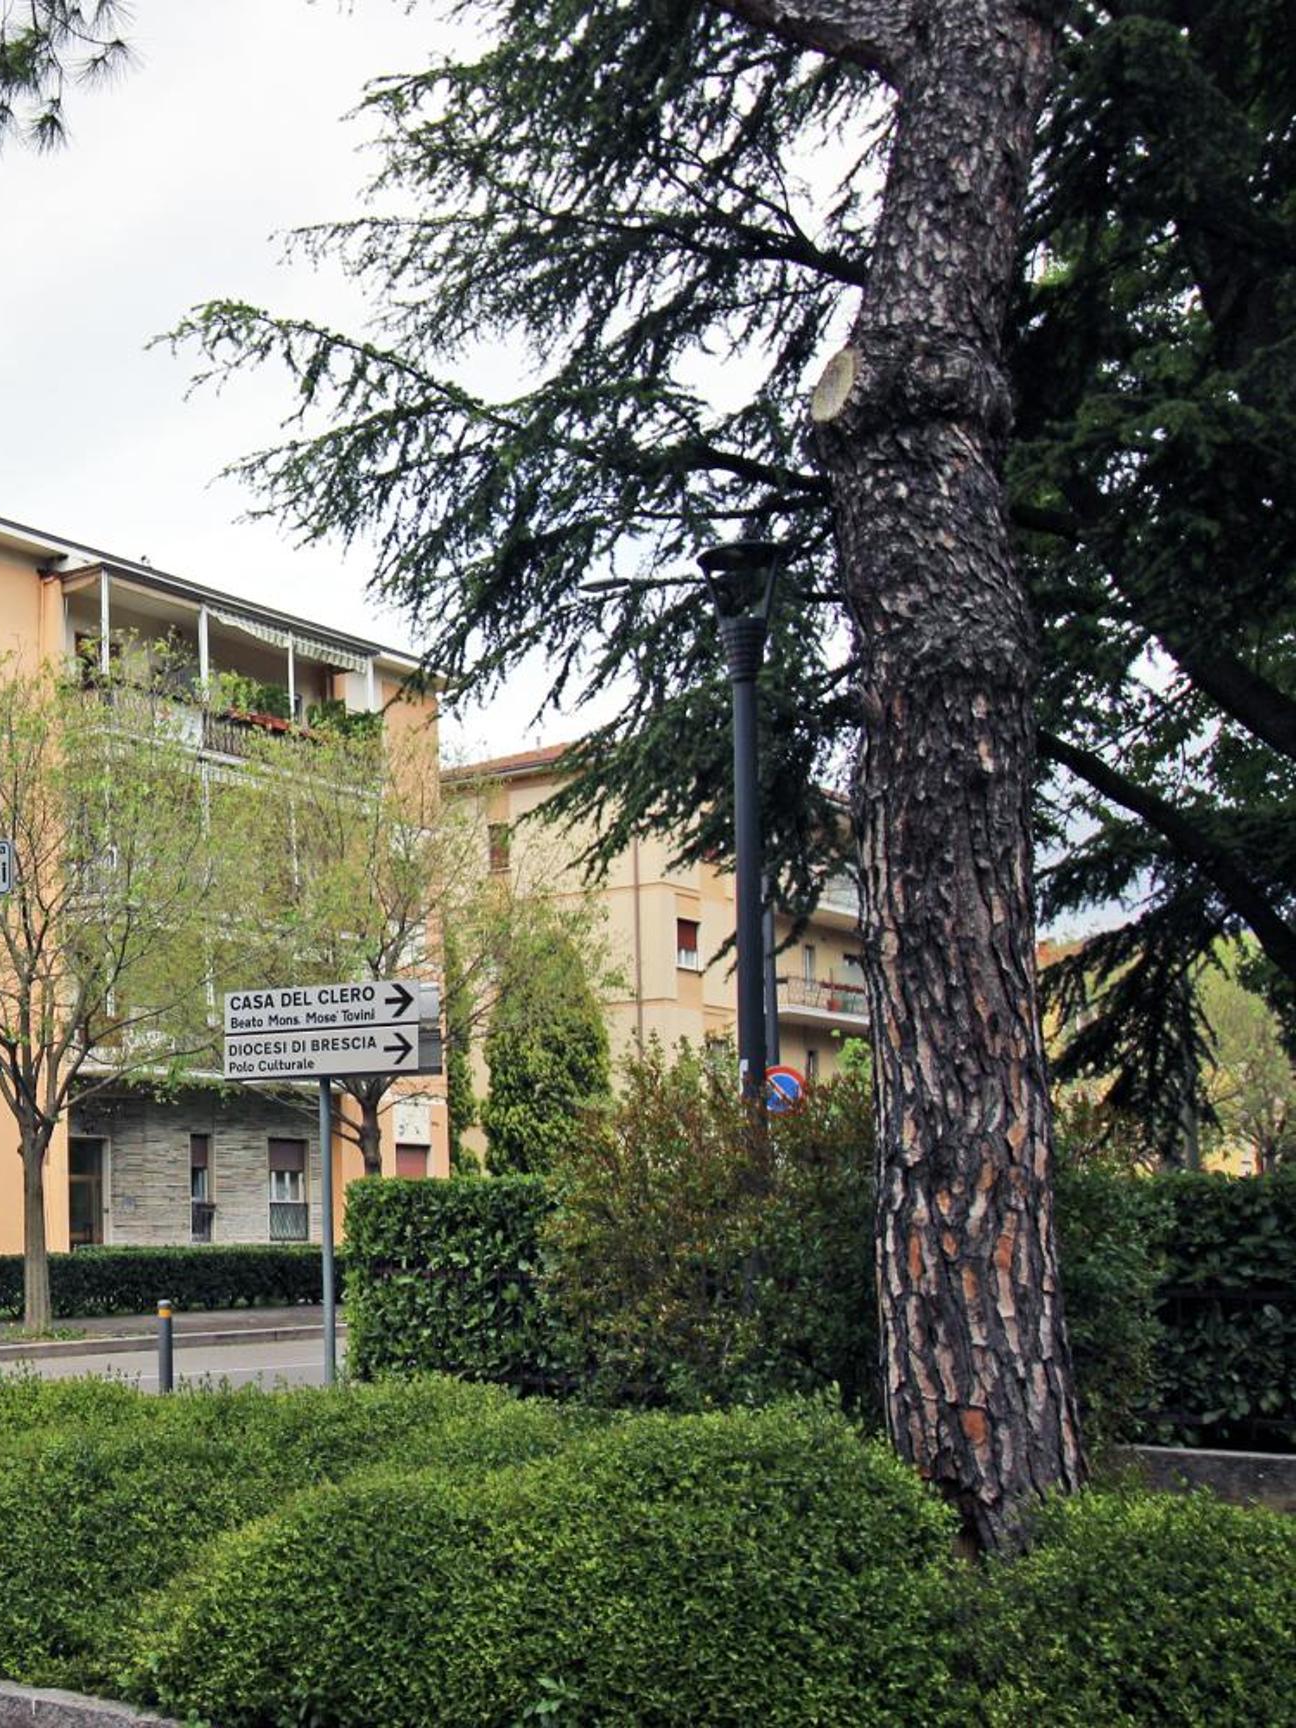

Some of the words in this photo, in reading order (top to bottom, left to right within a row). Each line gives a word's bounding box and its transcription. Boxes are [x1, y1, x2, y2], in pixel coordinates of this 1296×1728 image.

[230, 993, 274, 1011] CASA
[281, 990, 313, 1008] DEL
[317, 986, 375, 1005] CLERO
[231, 1016, 264, 1029] Beato
[341, 1008, 375, 1022] Tovini
[229, 1041, 286, 1057] DIOCESI
[292, 1040, 306, 1053] DI
[311, 1036, 377, 1052] BRESCIA
[229, 1062, 255, 1074] Polo
[258, 1058, 315, 1072] Culturale
